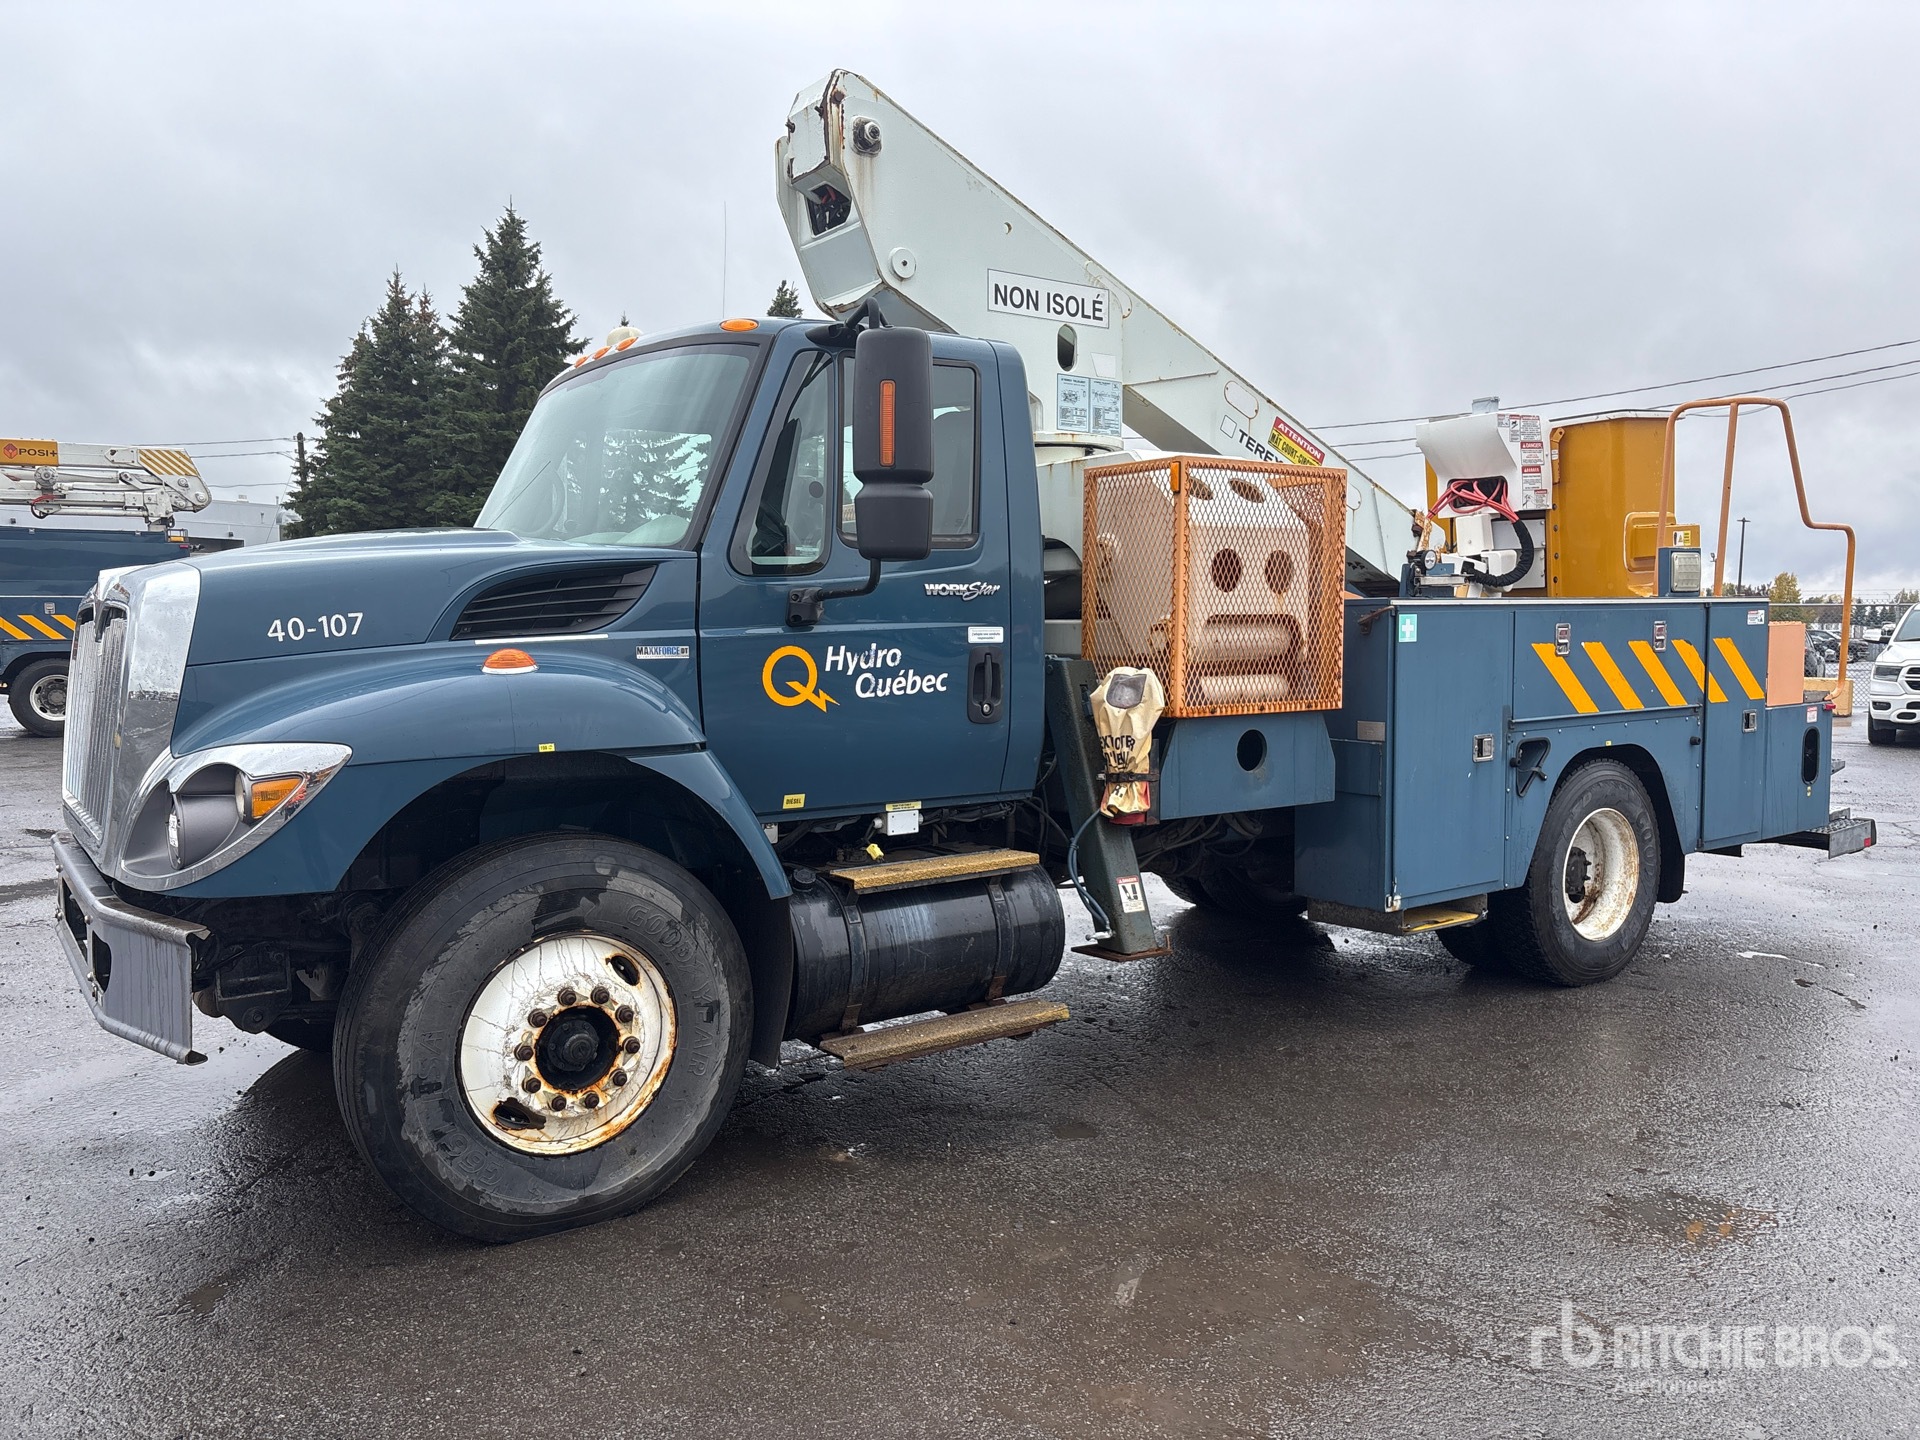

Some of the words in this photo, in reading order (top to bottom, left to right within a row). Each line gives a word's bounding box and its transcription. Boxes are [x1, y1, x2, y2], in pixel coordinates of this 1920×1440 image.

[994, 283, 1039, 311] NON
[1046, 292, 1103, 321] ISOLÉ
[19, 448, 58, 457] POSI+
[1239, 429, 1284, 463] TERE
[1278, 423, 1321, 460] ATTENTION
[267, 612, 363, 641] 40-107
[636, 646, 680, 656] MAXXFORCE
[825, 643, 902, 675] Hydro
[855, 669, 948, 698] Québec
